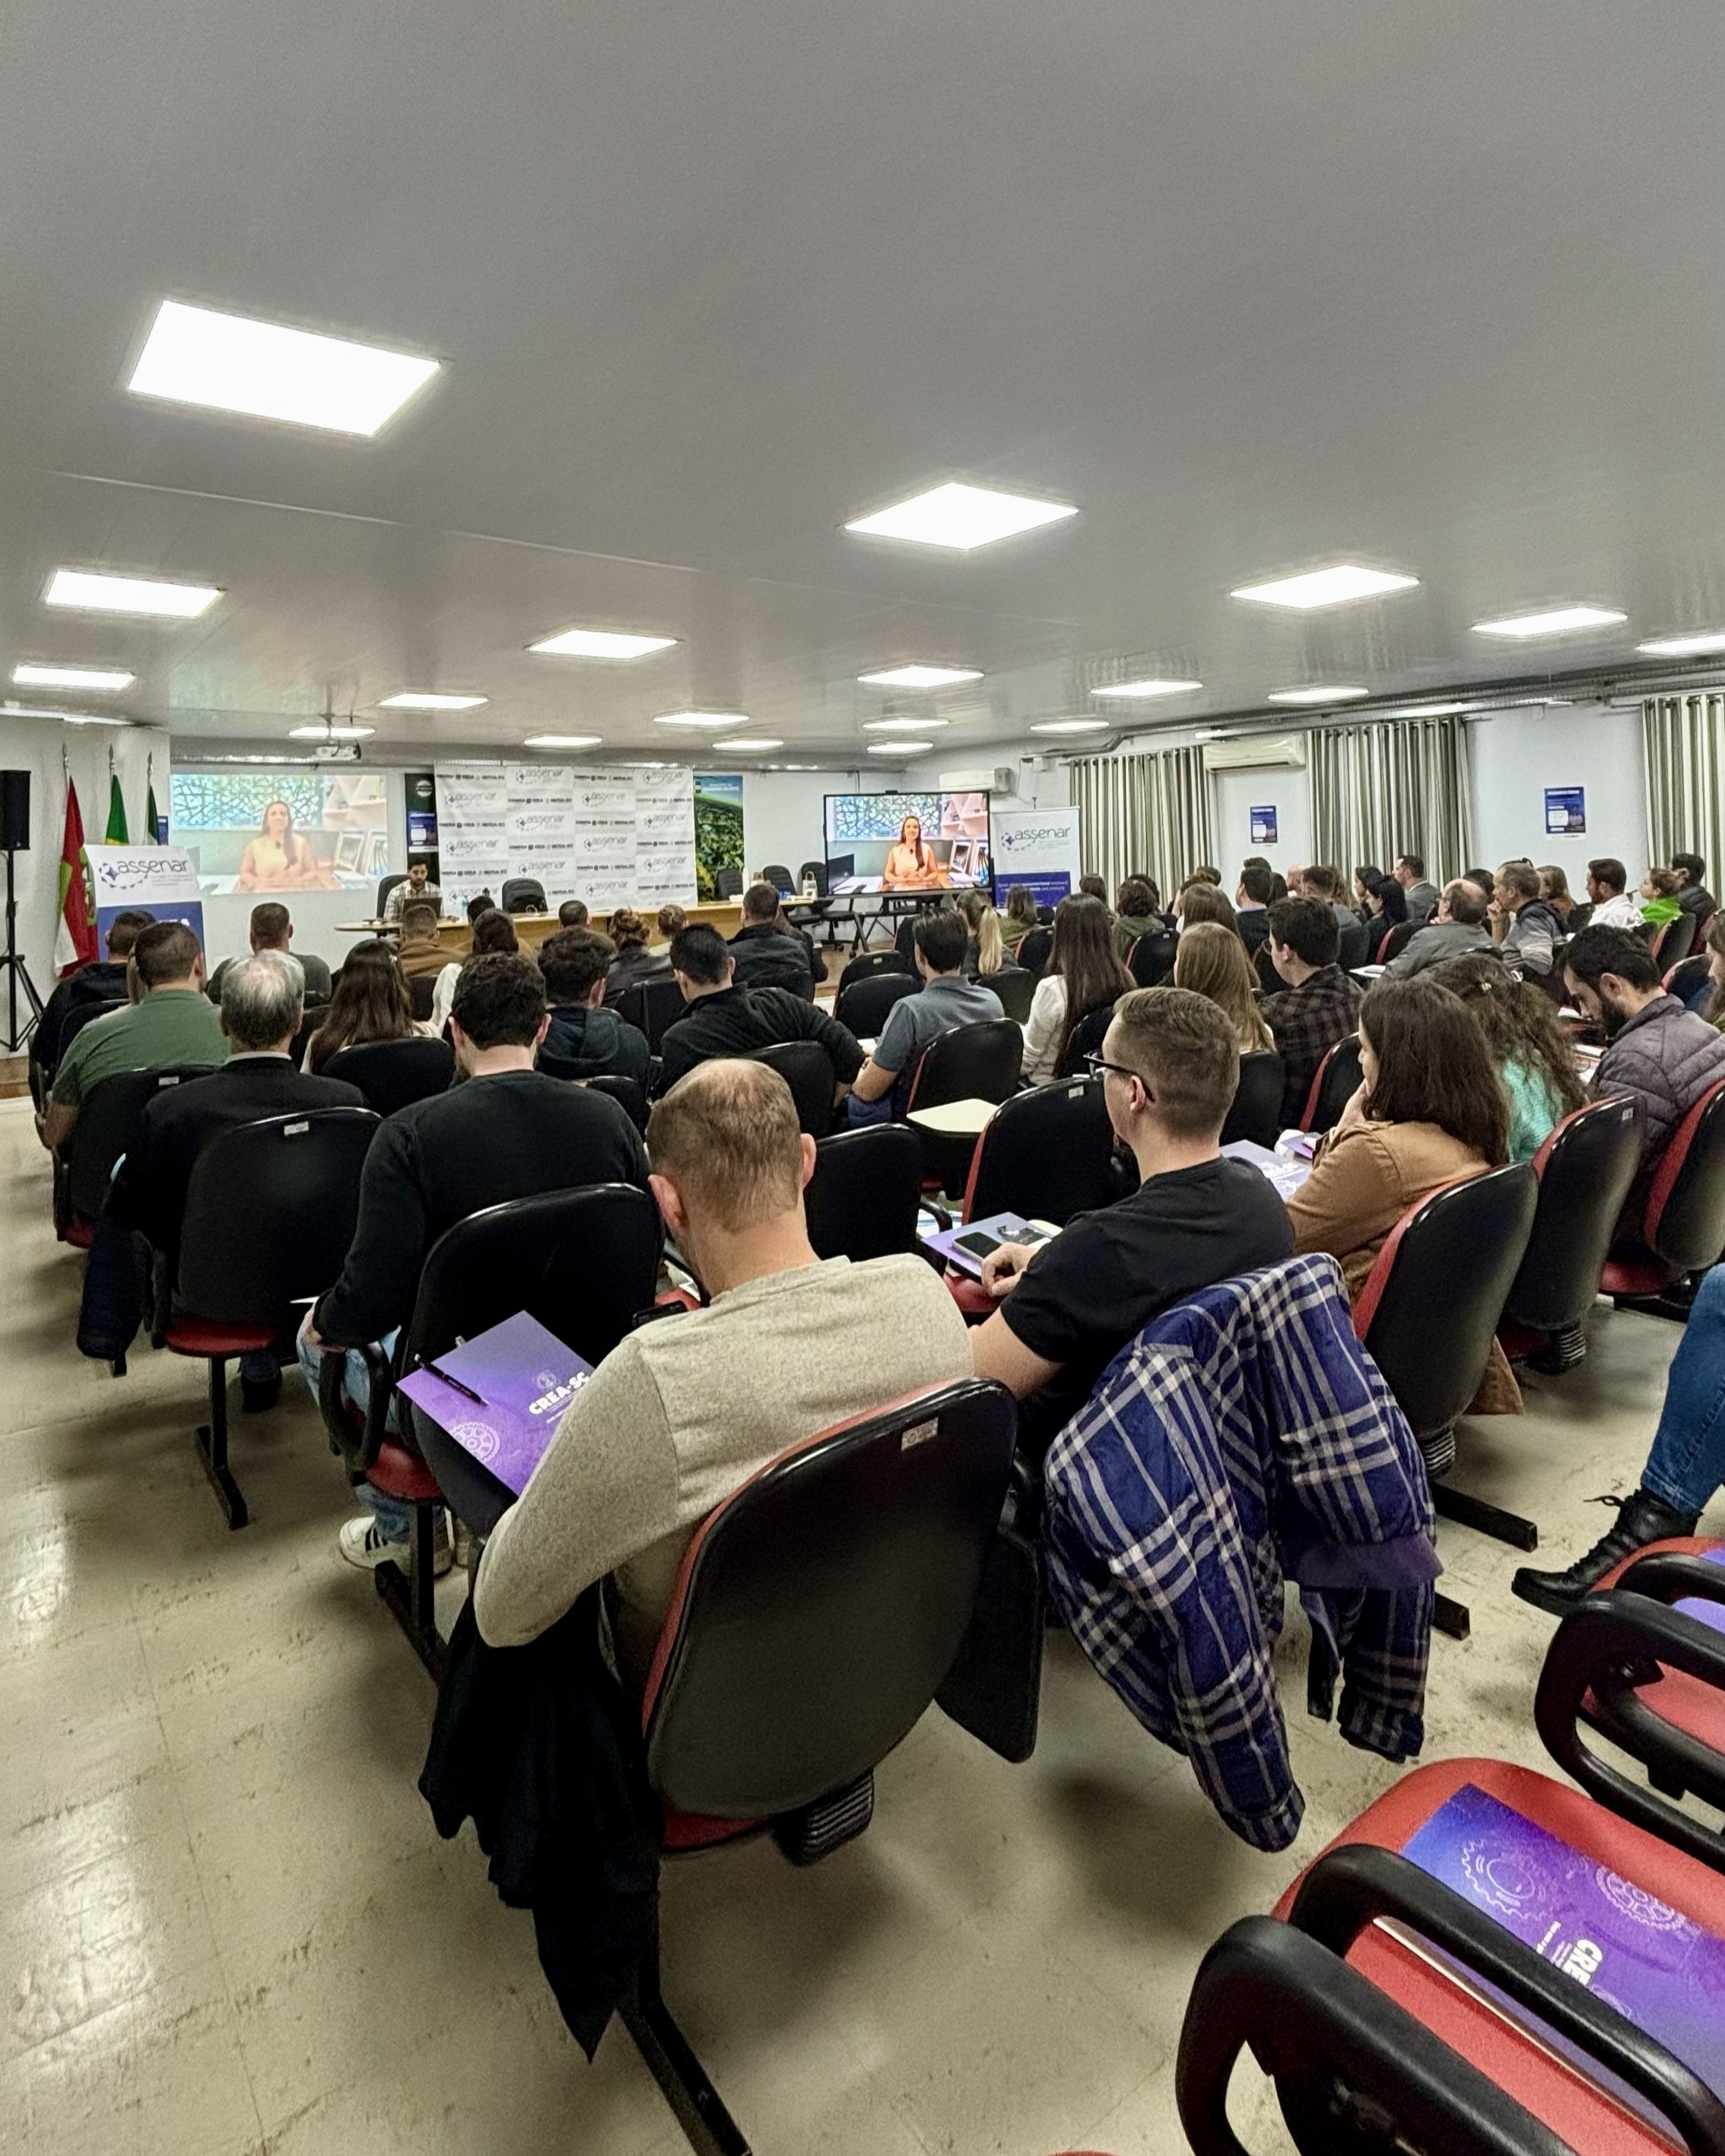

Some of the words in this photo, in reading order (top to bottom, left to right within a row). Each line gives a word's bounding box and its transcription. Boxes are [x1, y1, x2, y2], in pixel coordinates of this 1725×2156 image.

[1014, 827, 1071, 840] assenar
[116, 859, 188, 874] assenar
[529, 1371, 590, 1415] CREA-SC
